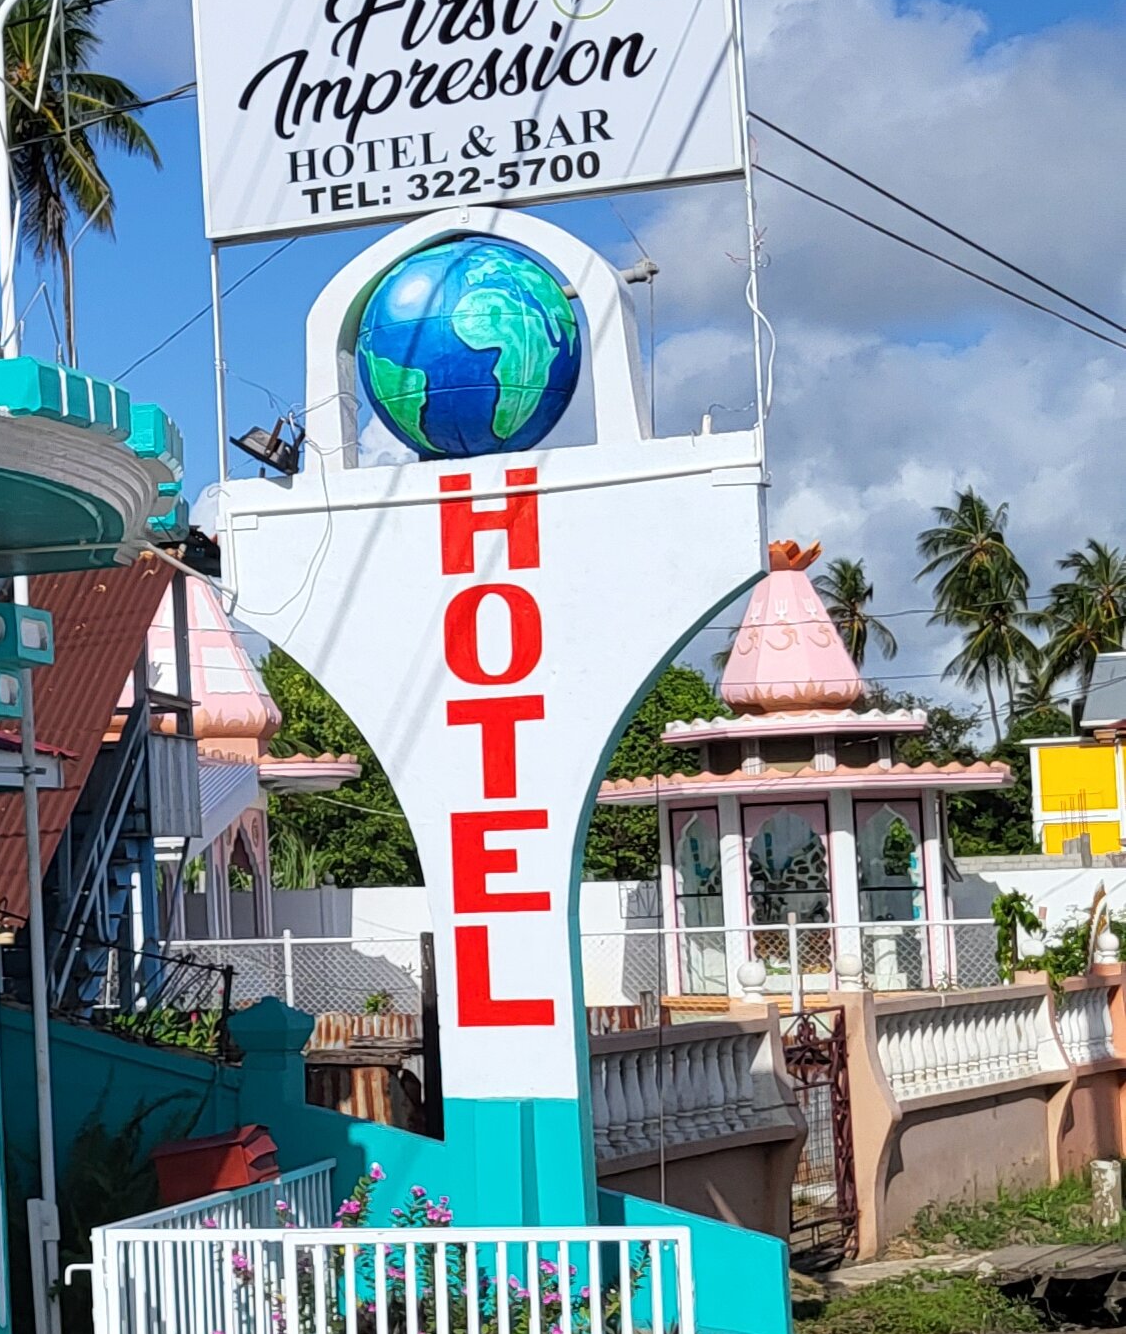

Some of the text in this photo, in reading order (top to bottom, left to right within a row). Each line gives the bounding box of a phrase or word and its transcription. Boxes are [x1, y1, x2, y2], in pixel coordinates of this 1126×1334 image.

[237, 20, 658, 144] Impression
[285, 108, 616, 184] HOTEL & BAR
[301, 151, 601, 214] TEL: 322-5700
[438, 466, 556, 1028] HOTEL
